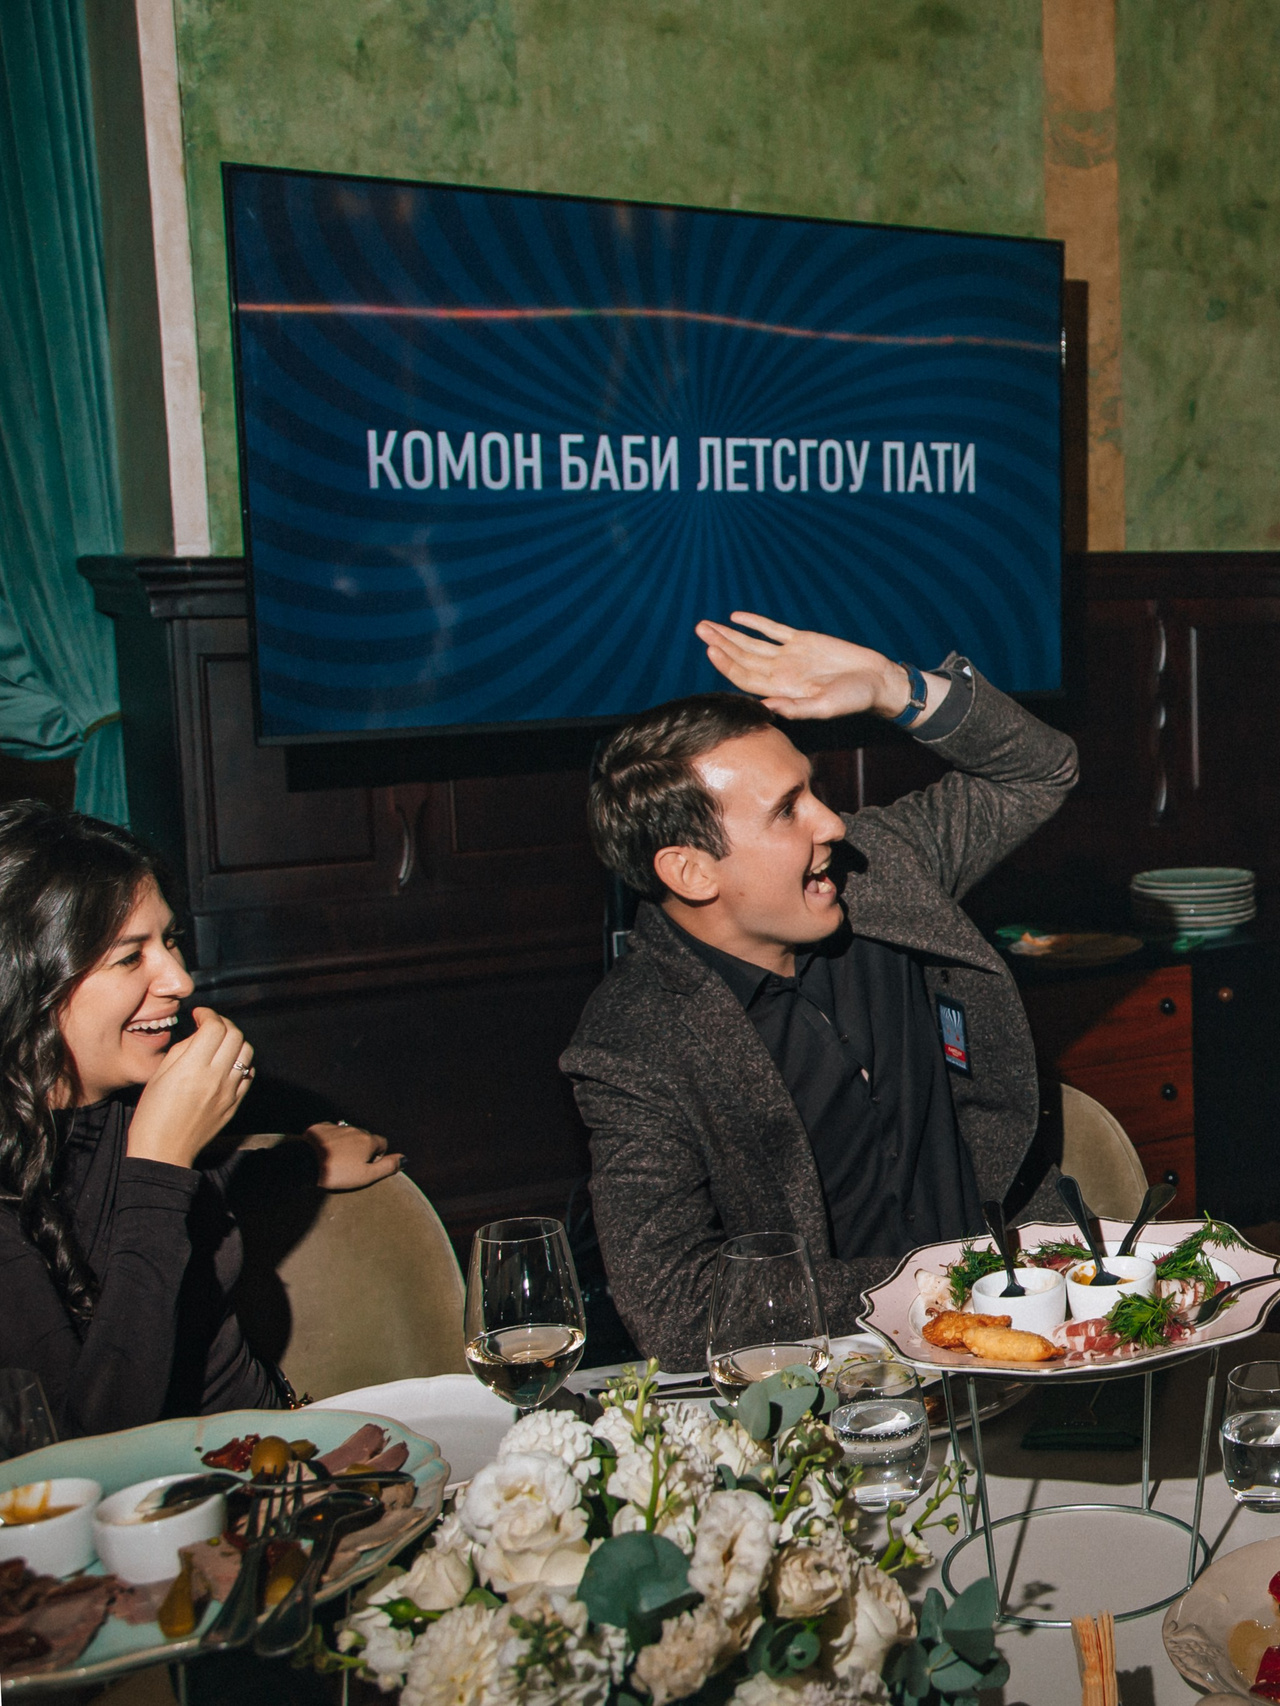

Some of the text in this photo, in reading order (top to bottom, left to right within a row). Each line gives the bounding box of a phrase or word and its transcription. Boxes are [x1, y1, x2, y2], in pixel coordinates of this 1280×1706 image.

[367, 430, 977, 494] КОМОН БАБИ ЛЕТСГОУ ПАТИ
